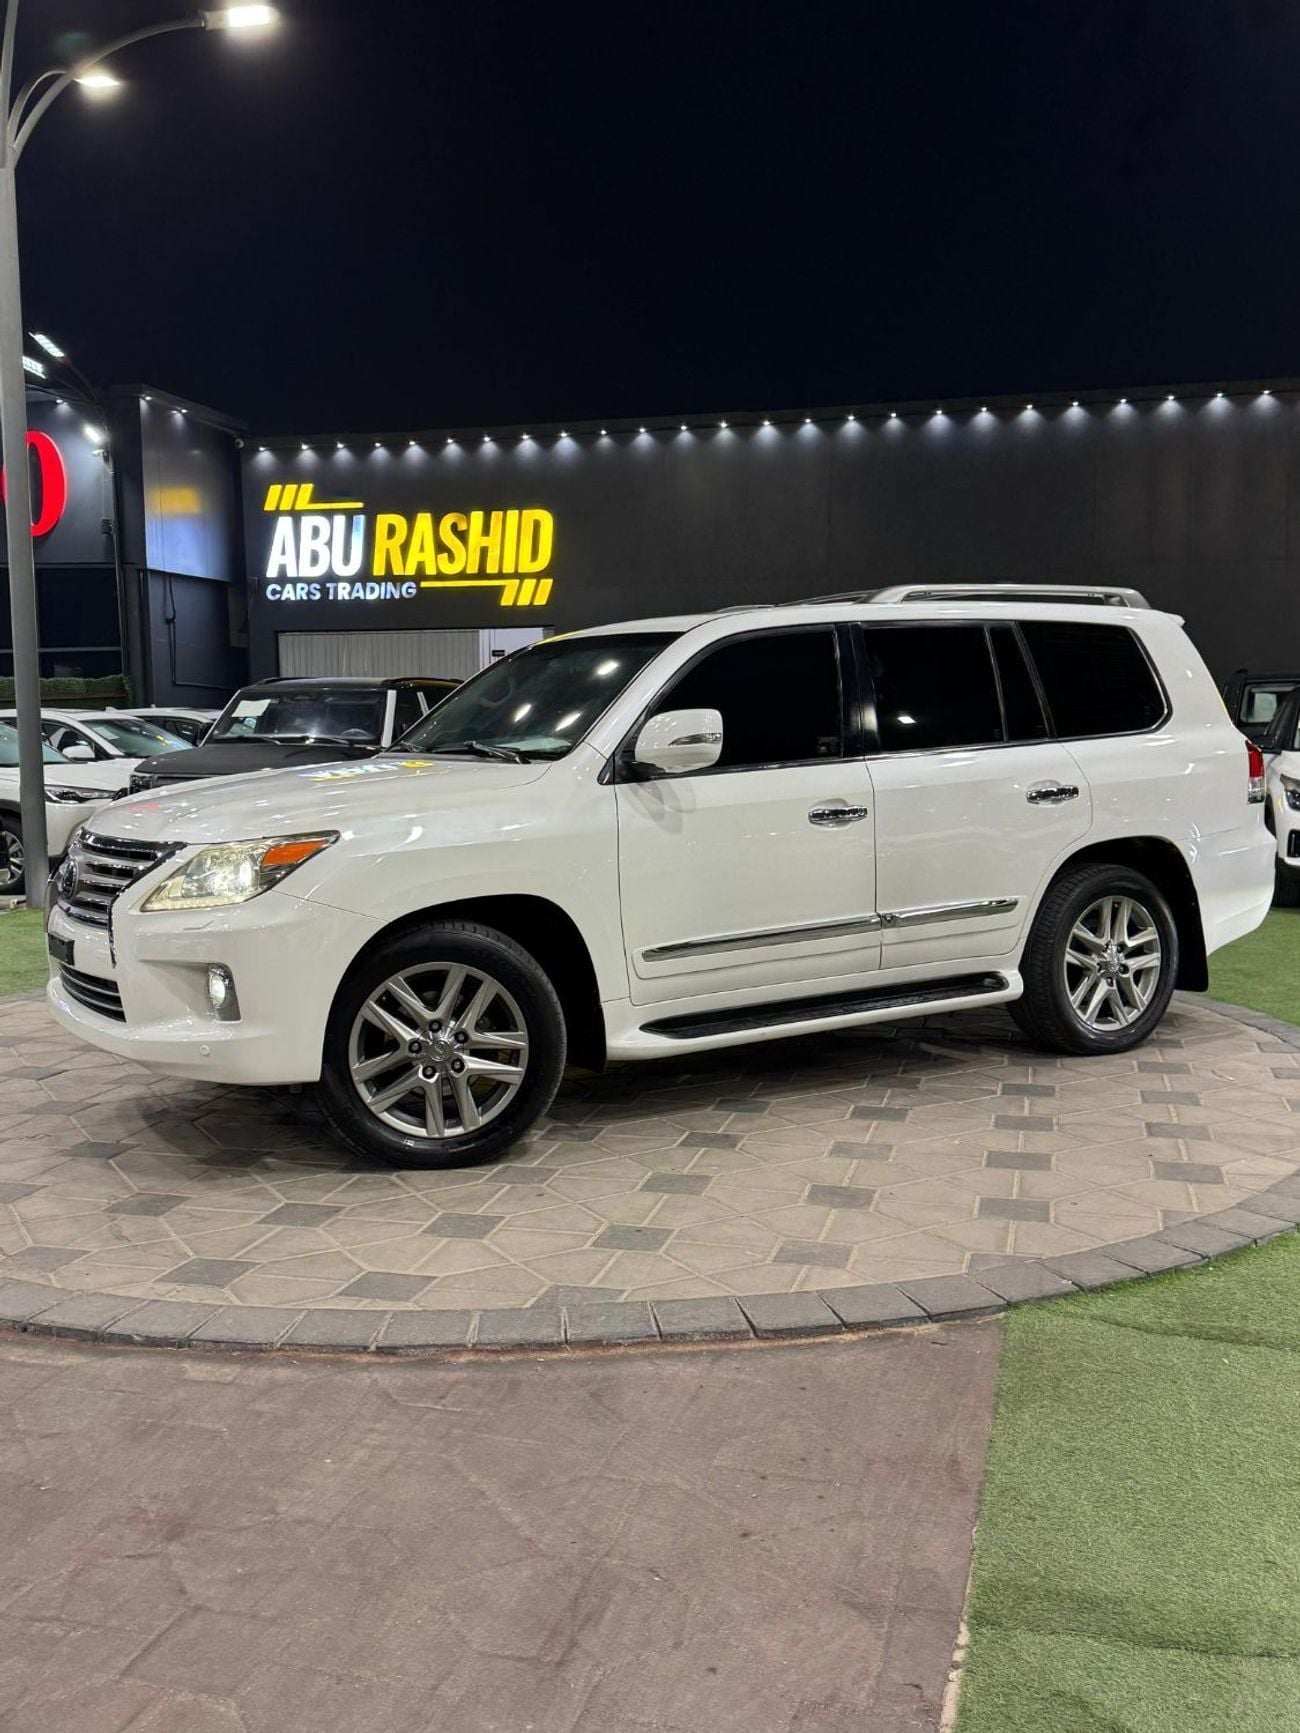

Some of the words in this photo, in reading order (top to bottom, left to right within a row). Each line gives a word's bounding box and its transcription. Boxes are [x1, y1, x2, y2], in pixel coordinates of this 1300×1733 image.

[266, 514, 365, 578] ABU
[372, 509, 554, 576] RASHID
[265, 583, 321, 601] CARS
[326, 581, 417, 600] TRADING
